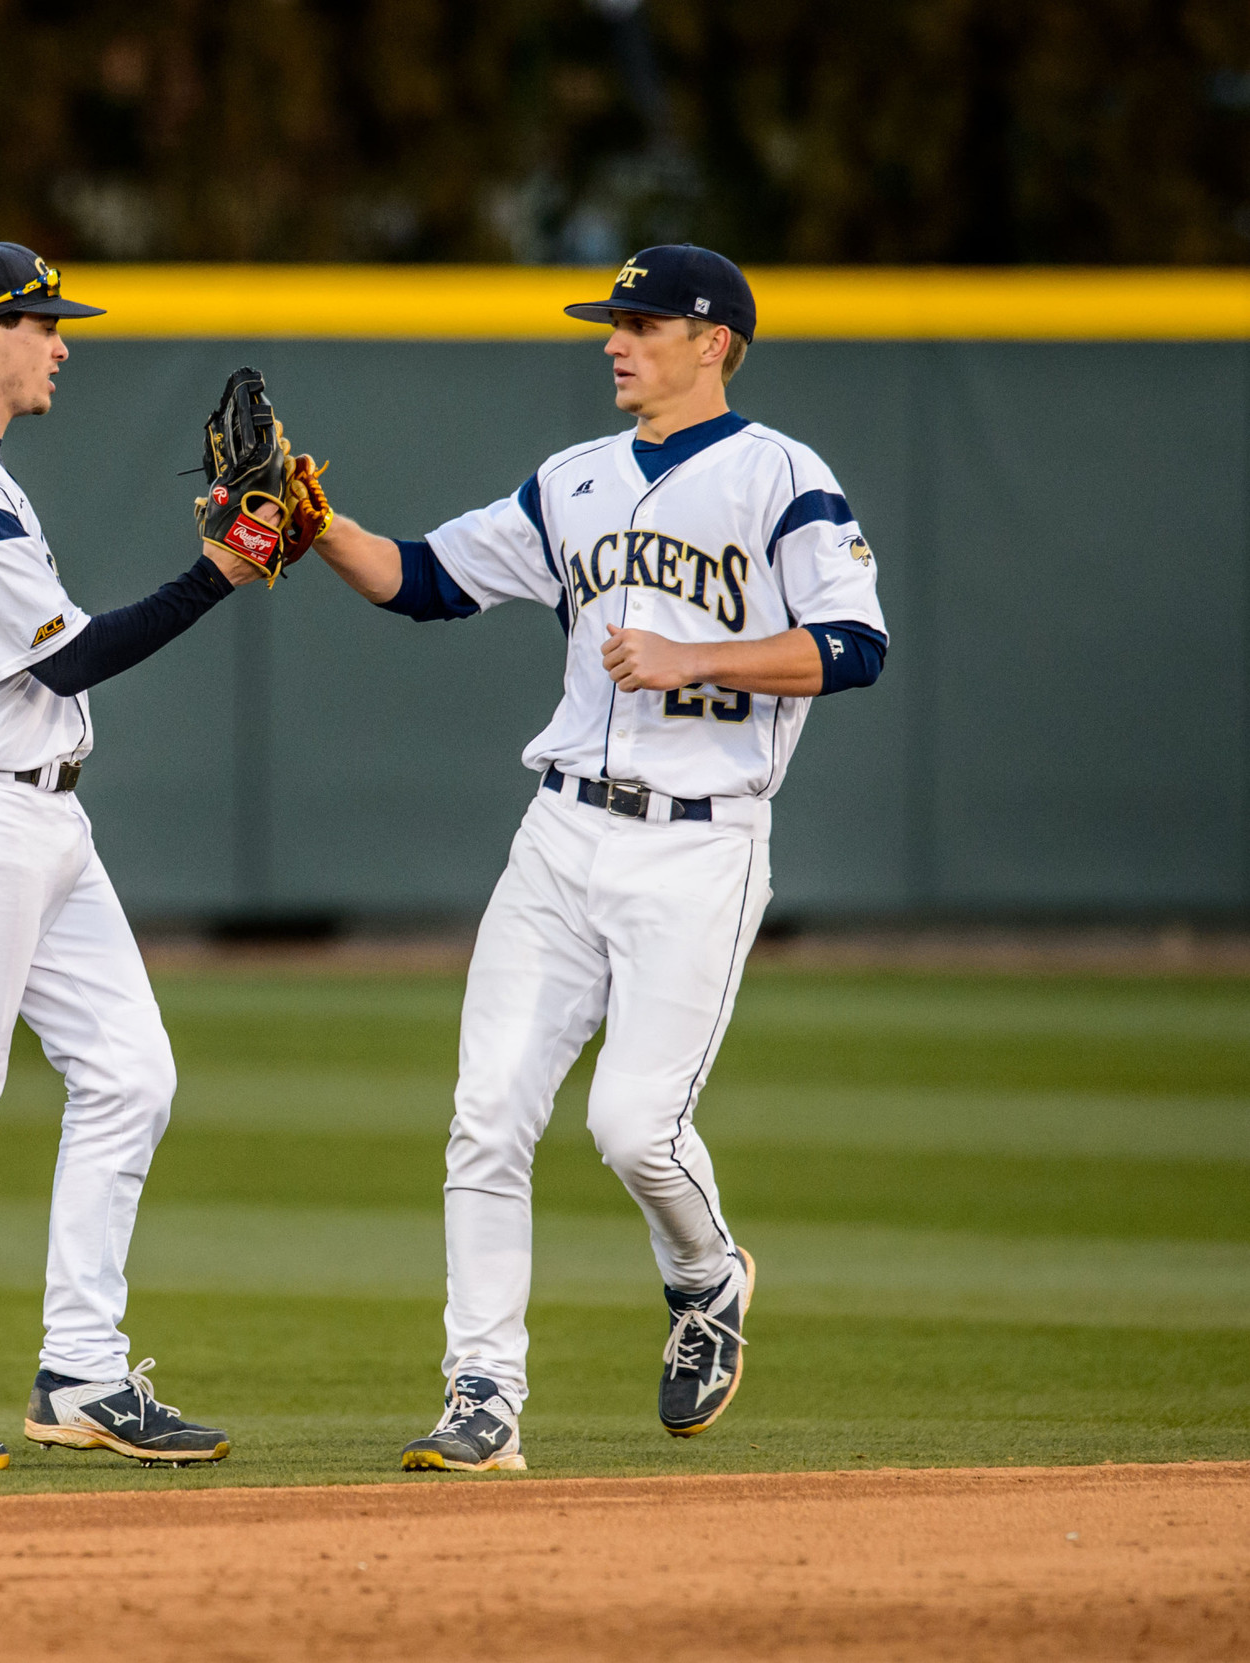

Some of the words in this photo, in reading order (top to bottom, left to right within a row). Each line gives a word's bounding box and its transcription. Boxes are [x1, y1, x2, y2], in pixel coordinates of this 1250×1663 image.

[213, 487, 227, 504] R
[233, 526, 272, 551] Rawlings
[32, 614, 65, 647] ACC
